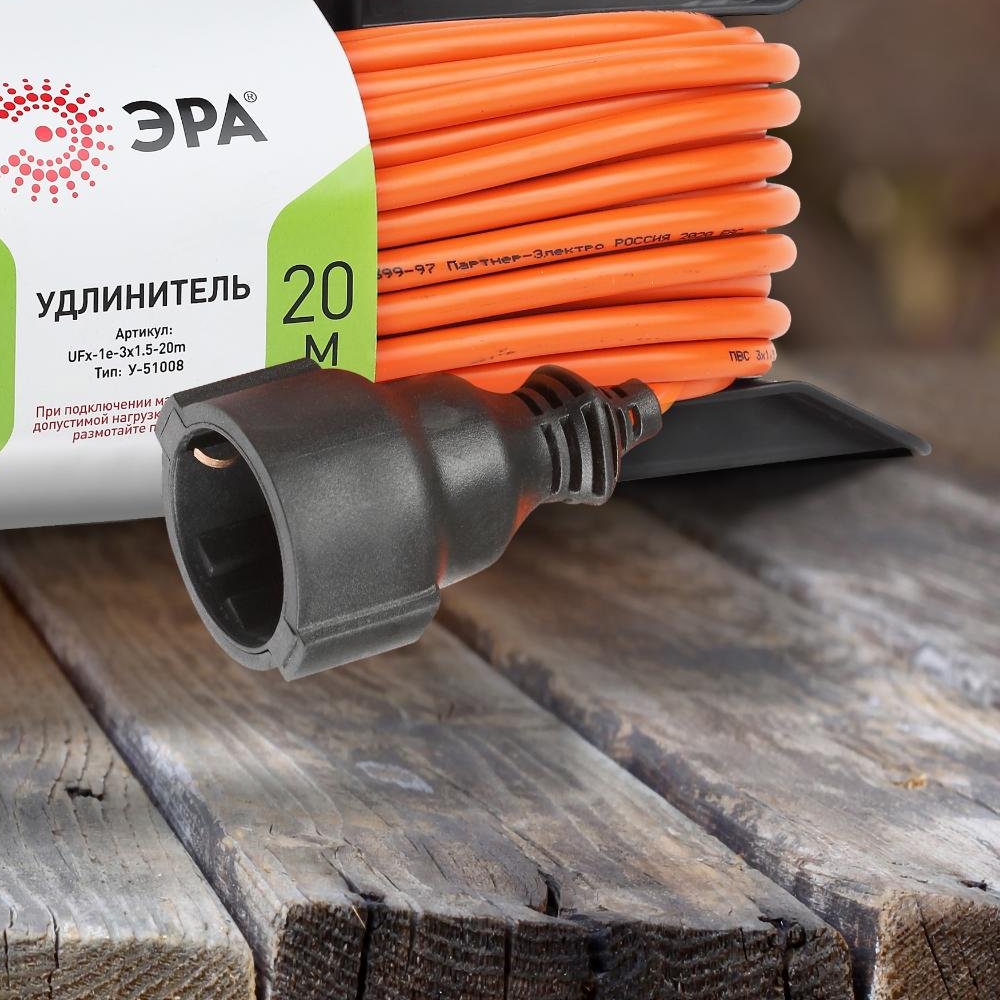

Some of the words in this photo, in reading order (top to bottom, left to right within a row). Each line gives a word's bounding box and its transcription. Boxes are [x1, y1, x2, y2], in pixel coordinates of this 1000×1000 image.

[446, 242, 605, 272] Партнер-Электро
[614, 233, 672, 248] РОССИЯ
[35, 274, 252, 323] УДЛИНИТЕЛЬ
[282, 260, 354, 325] 20
[115, 326, 173, 342] Артикул:
[68, 341, 186, 363] UFx-1e-3x1.5-20m
[728, 350, 750, 362] ПВС
[94, 366, 123, 379] Тип:
[128, 359, 185, 377] У-51008
[36, 405, 62, 420] При
[64, 398, 152, 417] подключении
[32, 413, 110, 434] допустимой
[72, 423, 146, 443] размотайте
